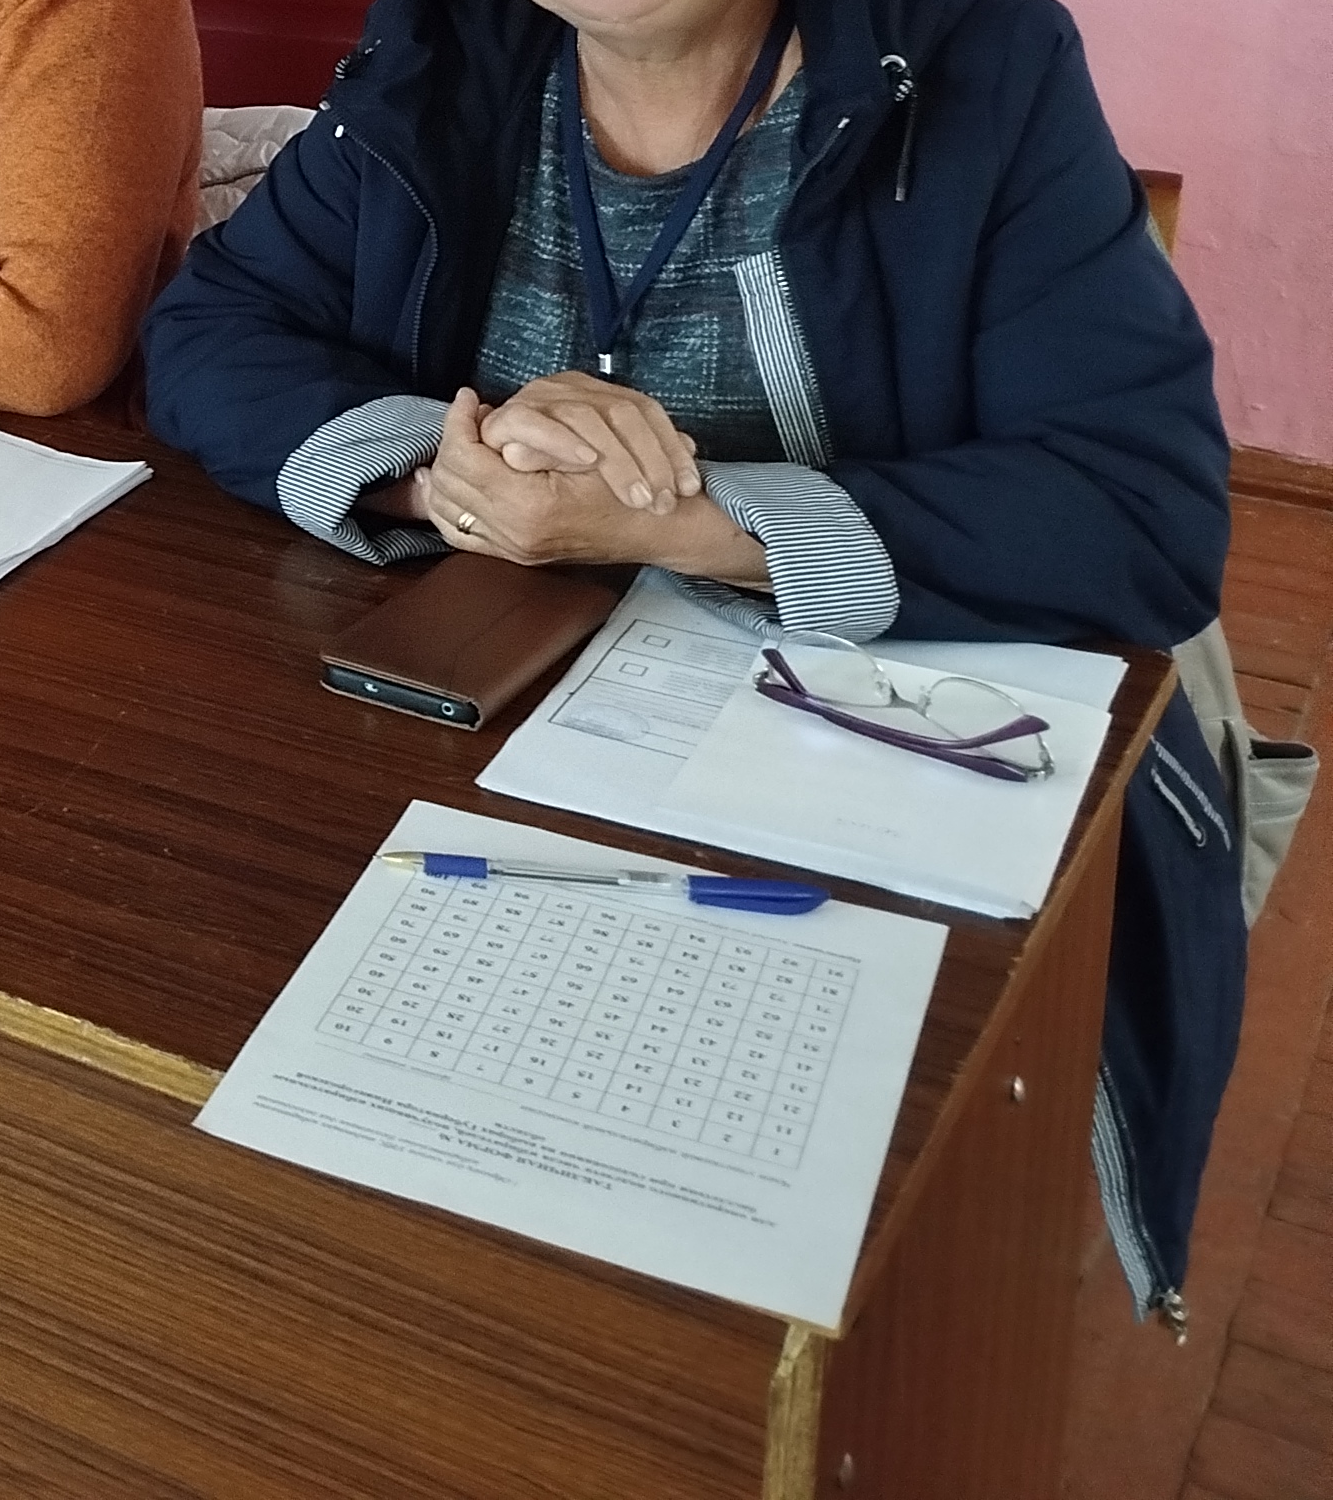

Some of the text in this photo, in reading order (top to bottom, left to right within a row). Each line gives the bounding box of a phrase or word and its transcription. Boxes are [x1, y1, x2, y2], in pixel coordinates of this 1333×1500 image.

[410, 903, 691, 978] 74 80
[442, 930, 781, 1021] 62 63 64 65 66 67 68 69
[592, 928, 839, 996] 81 82 83 84 85 86
[389, 935, 773, 1040] 52 53 54 55 56 57 58 59 60
[334, 1022, 351, 1032] 10
[379, 952, 813, 1072] 41 42 43 44 45 46 47 48 49 50
[368, 969, 807, 1094] 31 32 33 34 35 36 37 38 39 40
[357, 987, 801, 1114] 21 22 23 24 25 26 27 28 29 30
[429, 1050, 440, 1058] 8
[346, 1004, 792, 1136] 11 12 13 14 15 16 17 18 19 20
[523, 1077, 534, 1085] 6
[295, 1071, 394, 1106] Нижегородской
[571, 1091, 581, 1099] 5
[621, 1104, 631, 1112] 4
[671, 1120, 681, 1128] 3
[457, 1138, 514, 1161] ФОРМА
[723, 1134, 733, 1143] 2
[773, 1148, 780, 1156] 1
[516, 1155, 614, 1192] ТАБЛИЧНАЯ
